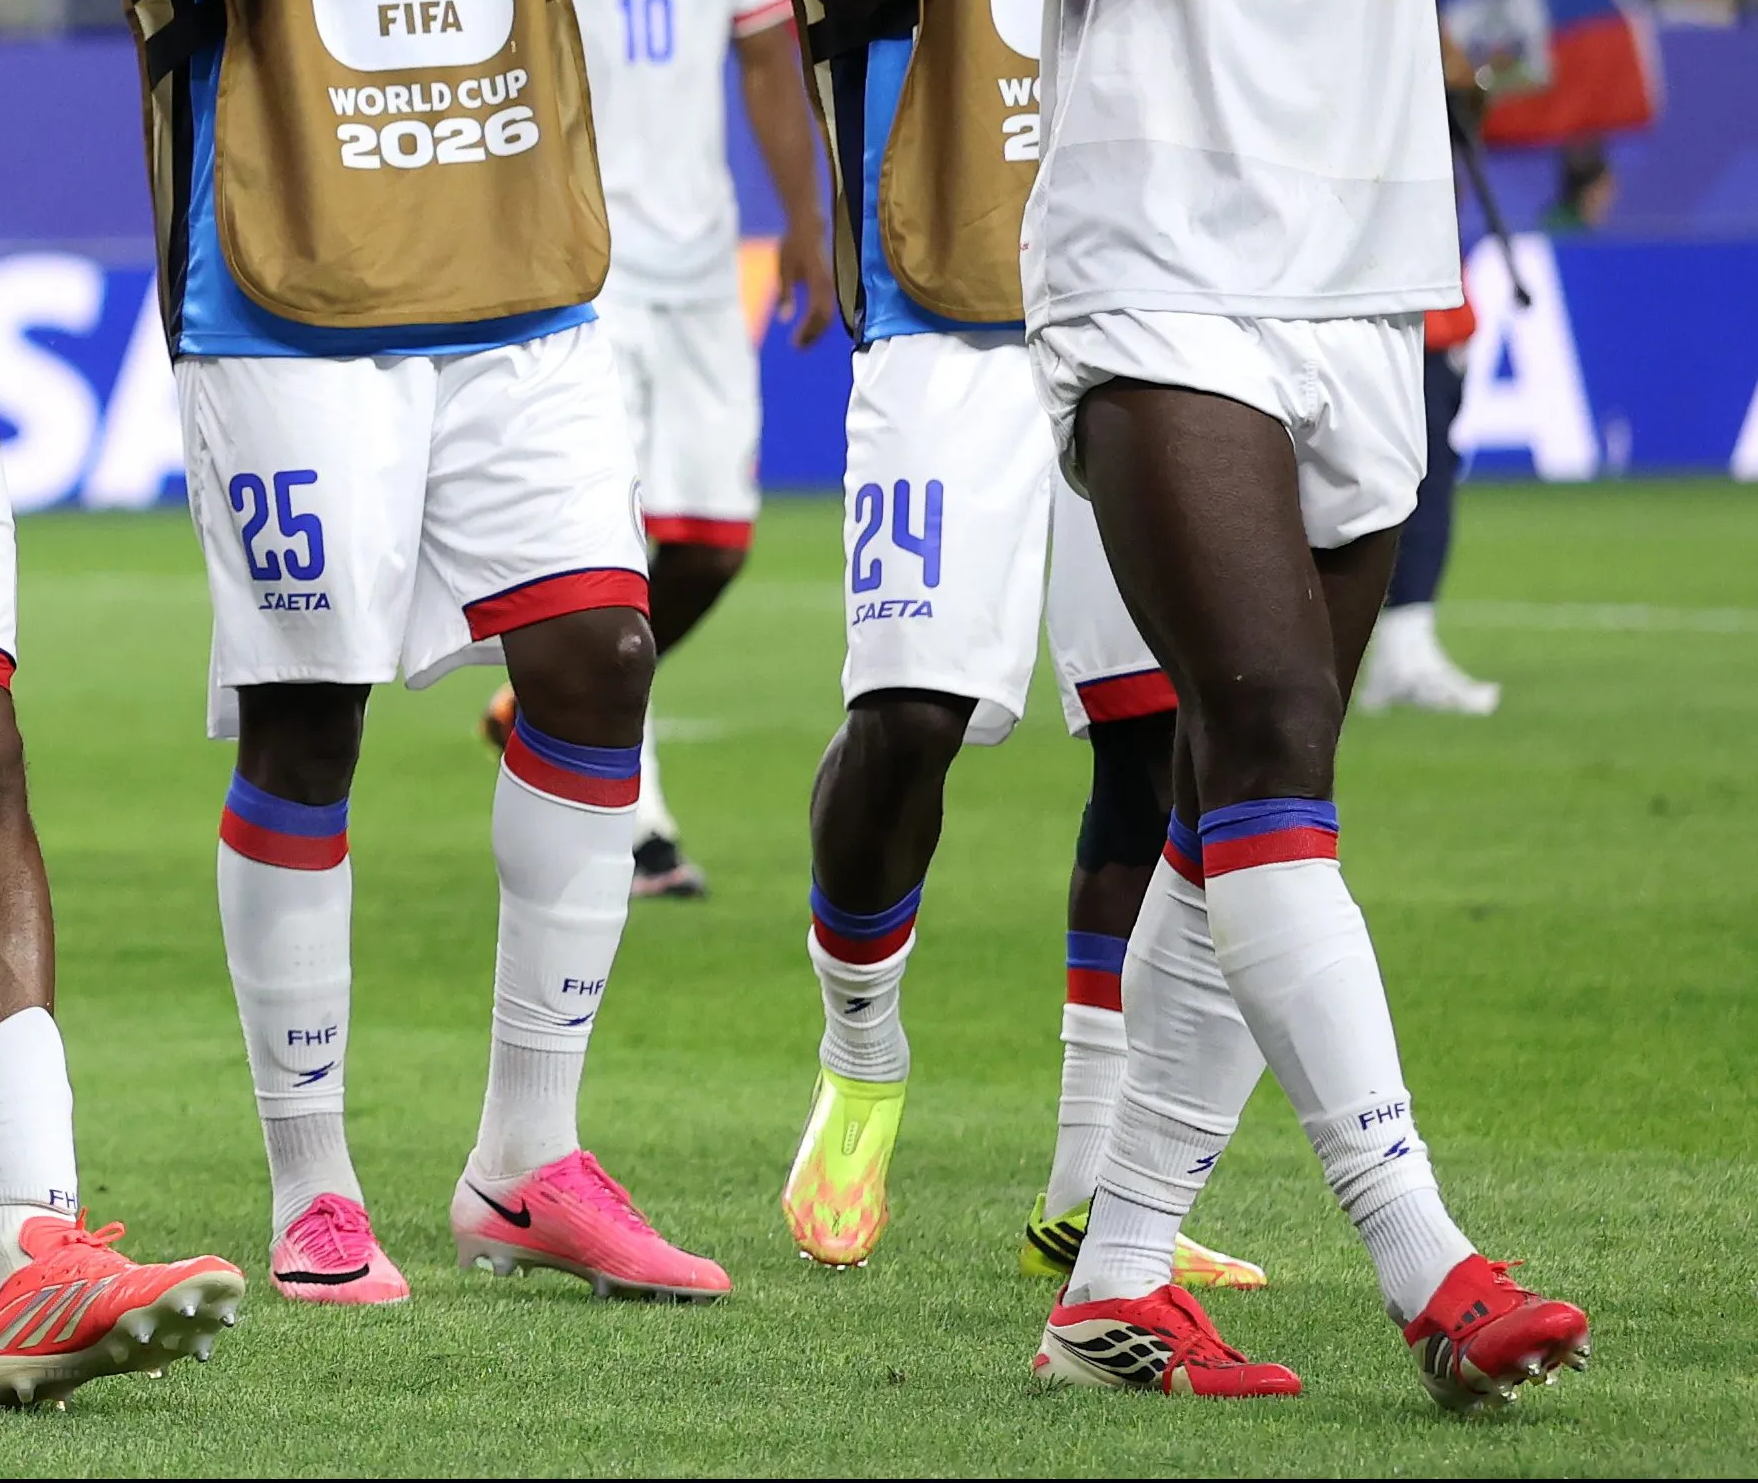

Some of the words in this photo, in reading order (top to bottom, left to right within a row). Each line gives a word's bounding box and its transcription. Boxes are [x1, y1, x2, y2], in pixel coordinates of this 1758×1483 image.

[377, 0, 464, 37] FIFA
[327, 81, 453, 117] WORLD
[456, 68, 529, 110] CUP
[336, 104, 541, 170] 2026
[229, 469, 325, 581] 25
[852, 479, 944, 594] 24
[259, 592, 331, 611] SAETA
[852, 600, 934, 626] SAETA
[562, 977, 605, 996] FHF
[287, 1025, 338, 1046] FHF
[1358, 1102, 1406, 1131] FHF
